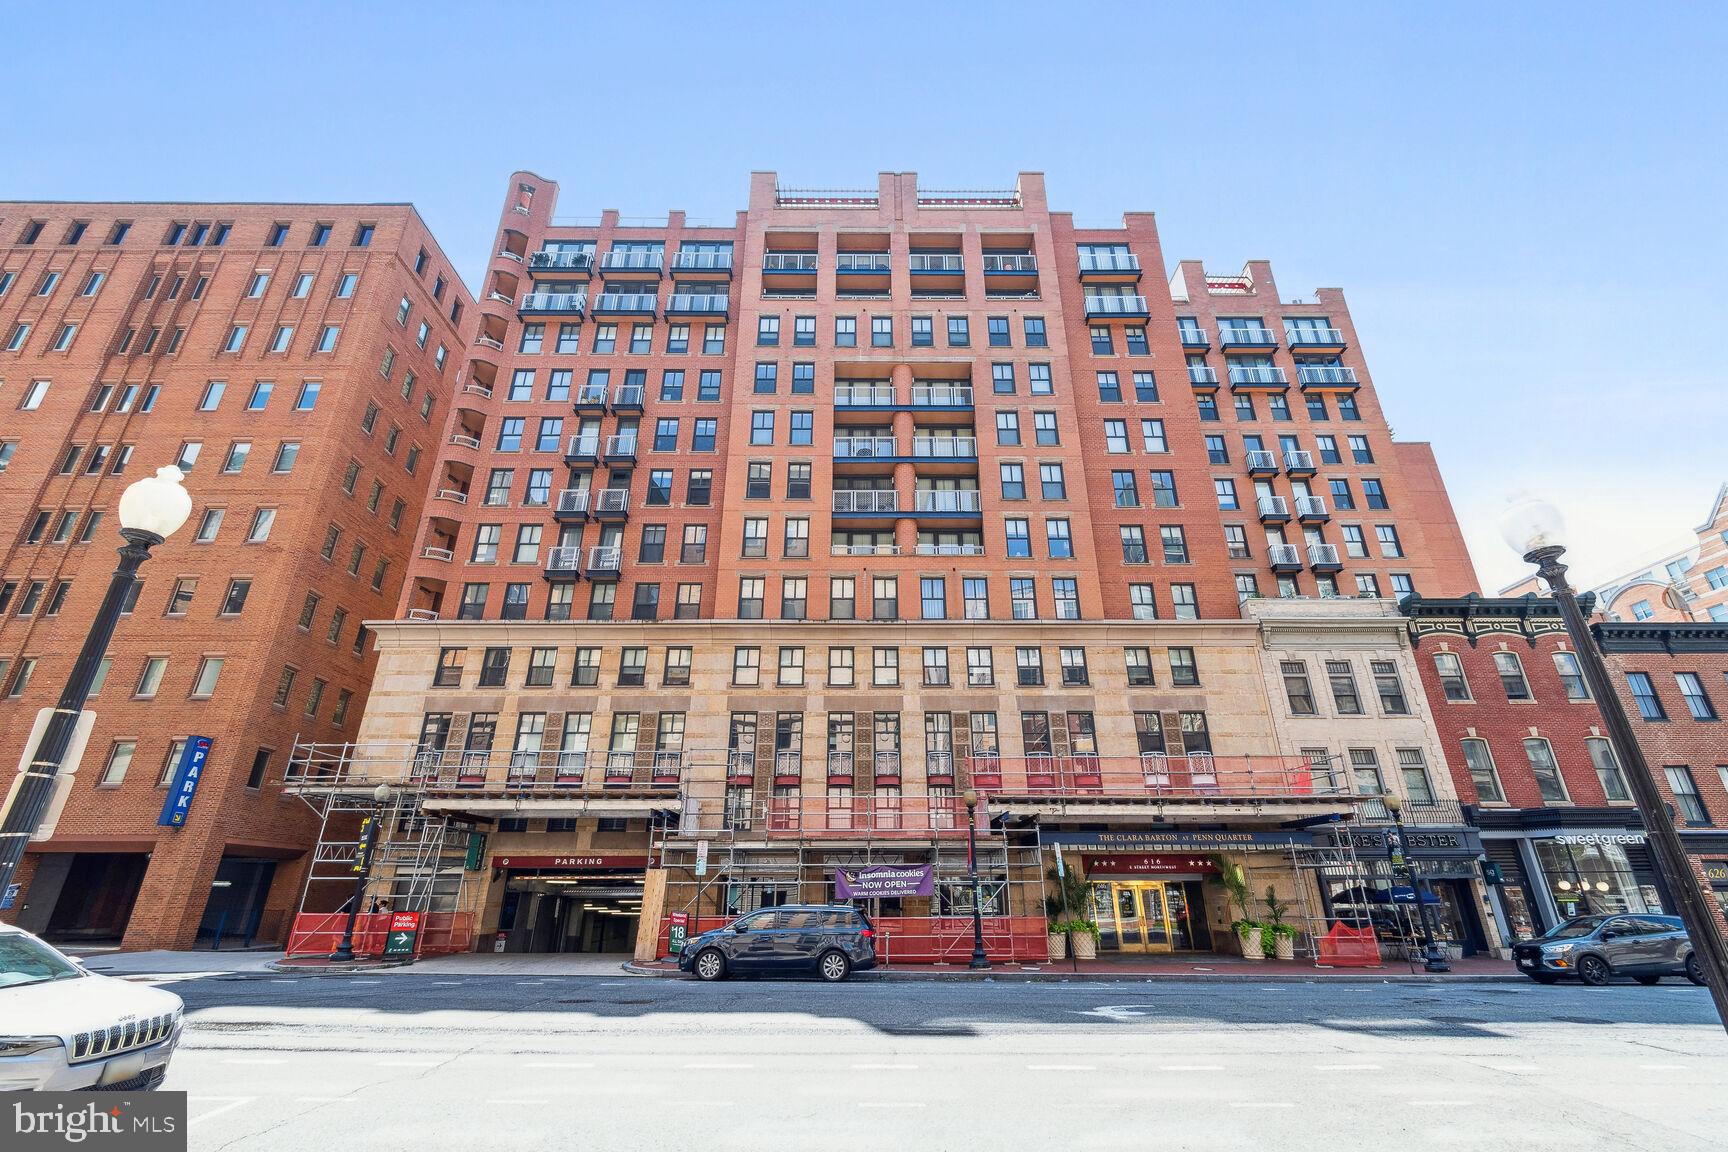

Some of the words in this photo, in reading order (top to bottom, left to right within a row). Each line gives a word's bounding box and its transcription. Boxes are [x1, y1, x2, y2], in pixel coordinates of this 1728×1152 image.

[177, 751, 205, 807] PARK
[1330, 834, 1383, 847] LUKE'S
[1555, 832, 1645, 846] sweetgreen
[896, 869, 924, 878] cookies
[1708, 868, 1726, 879] 626
[862, 881, 882, 889] NOW
[884, 880, 907, 888] OPEN
[393, 921, 415, 929] Parking
